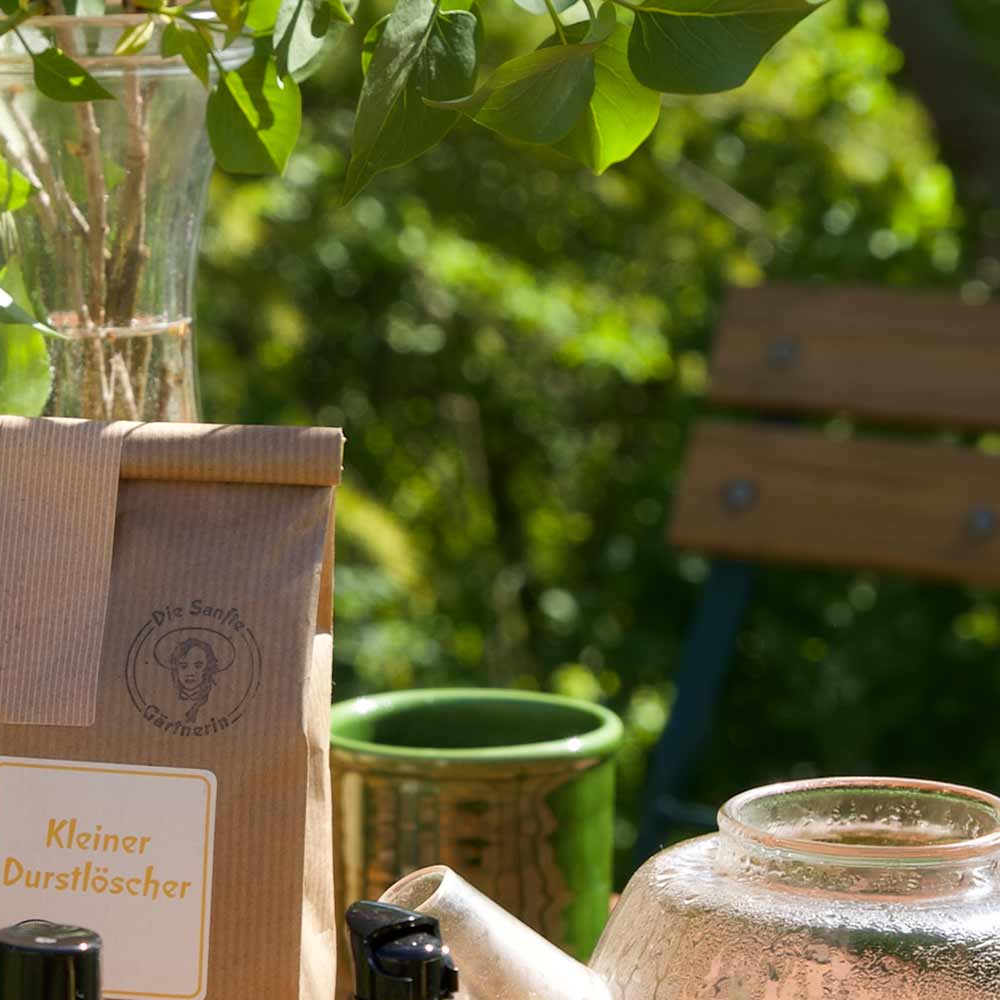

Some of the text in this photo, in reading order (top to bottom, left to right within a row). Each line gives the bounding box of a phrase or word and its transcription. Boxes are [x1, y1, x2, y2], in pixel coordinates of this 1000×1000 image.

[151, 600, 246, 632] Die Sanfte
[143, 705, 230, 737] Gärtnerin
[45, 818, 152, 855] Kleiner
[2, 856, 192, 901] Durstlöscher
